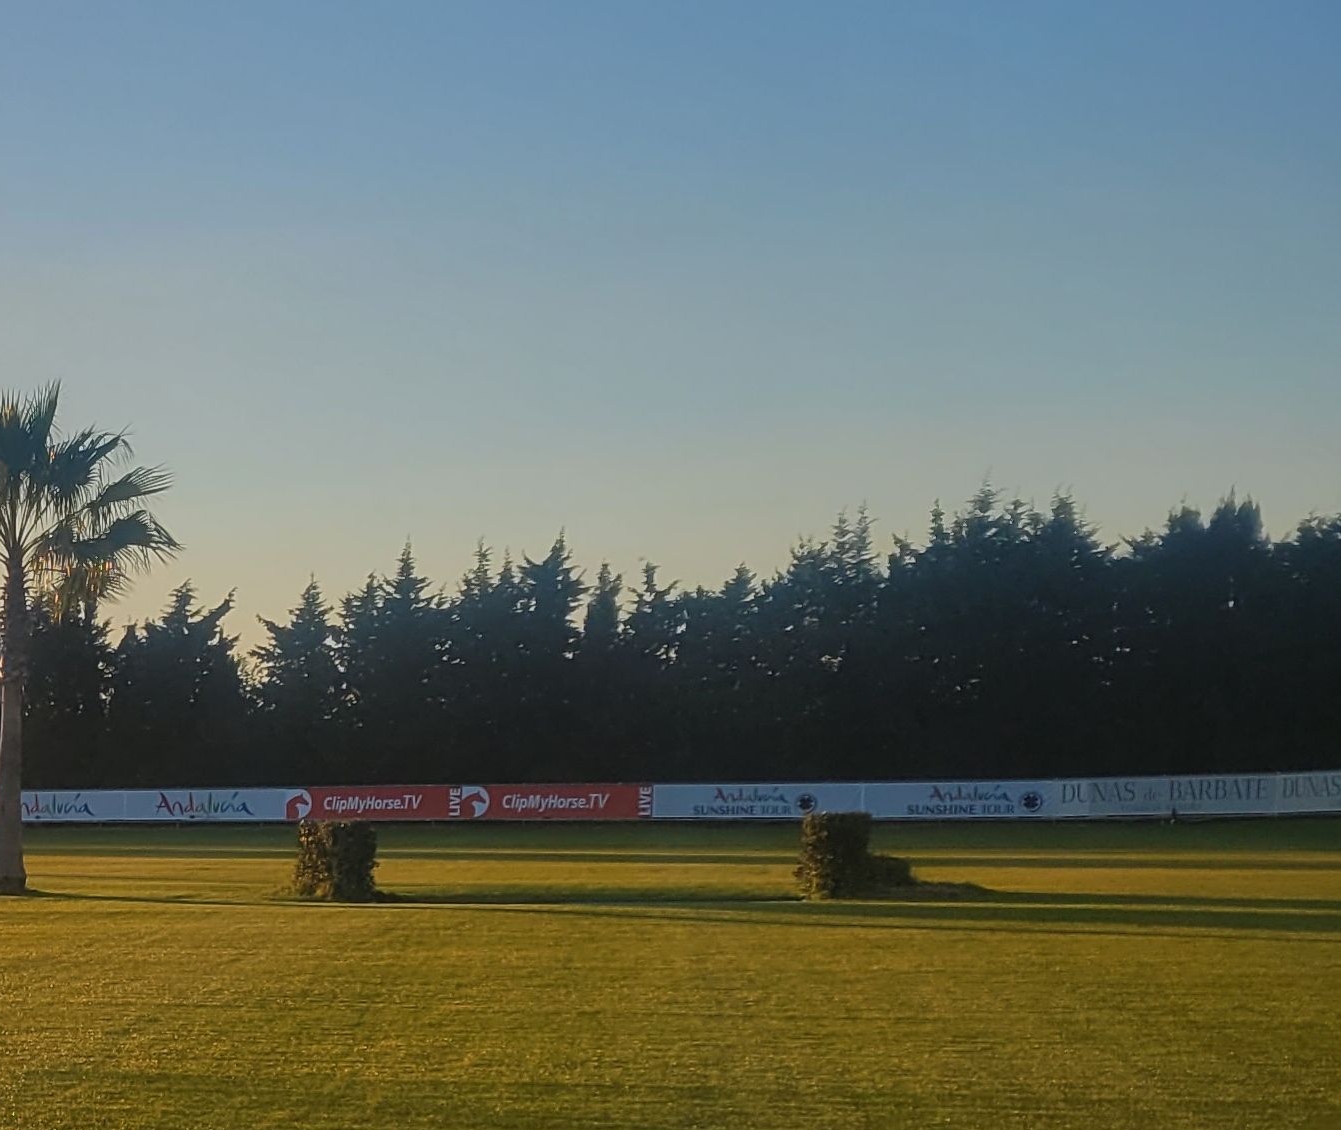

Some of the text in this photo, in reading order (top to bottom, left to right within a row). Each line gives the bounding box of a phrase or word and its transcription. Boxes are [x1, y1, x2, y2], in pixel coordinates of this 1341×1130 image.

[448, 787, 461, 817] LIVE
[637, 786, 652, 817] LIVE
[1062, 780, 1136, 804] DUNAS
[1170, 777, 1268, 802] BARBATE
[22, 793, 95, 817] ndalucía
[156, 791, 255, 817] Andalucía
[323, 794, 423, 814] ClipMyHorse.TV
[502, 793, 611, 813] ClipMyHorse.TV
[693, 804, 792, 816] SUNSHINE TOUR
[906, 803, 1015, 815] SUNSHINE TOUR
